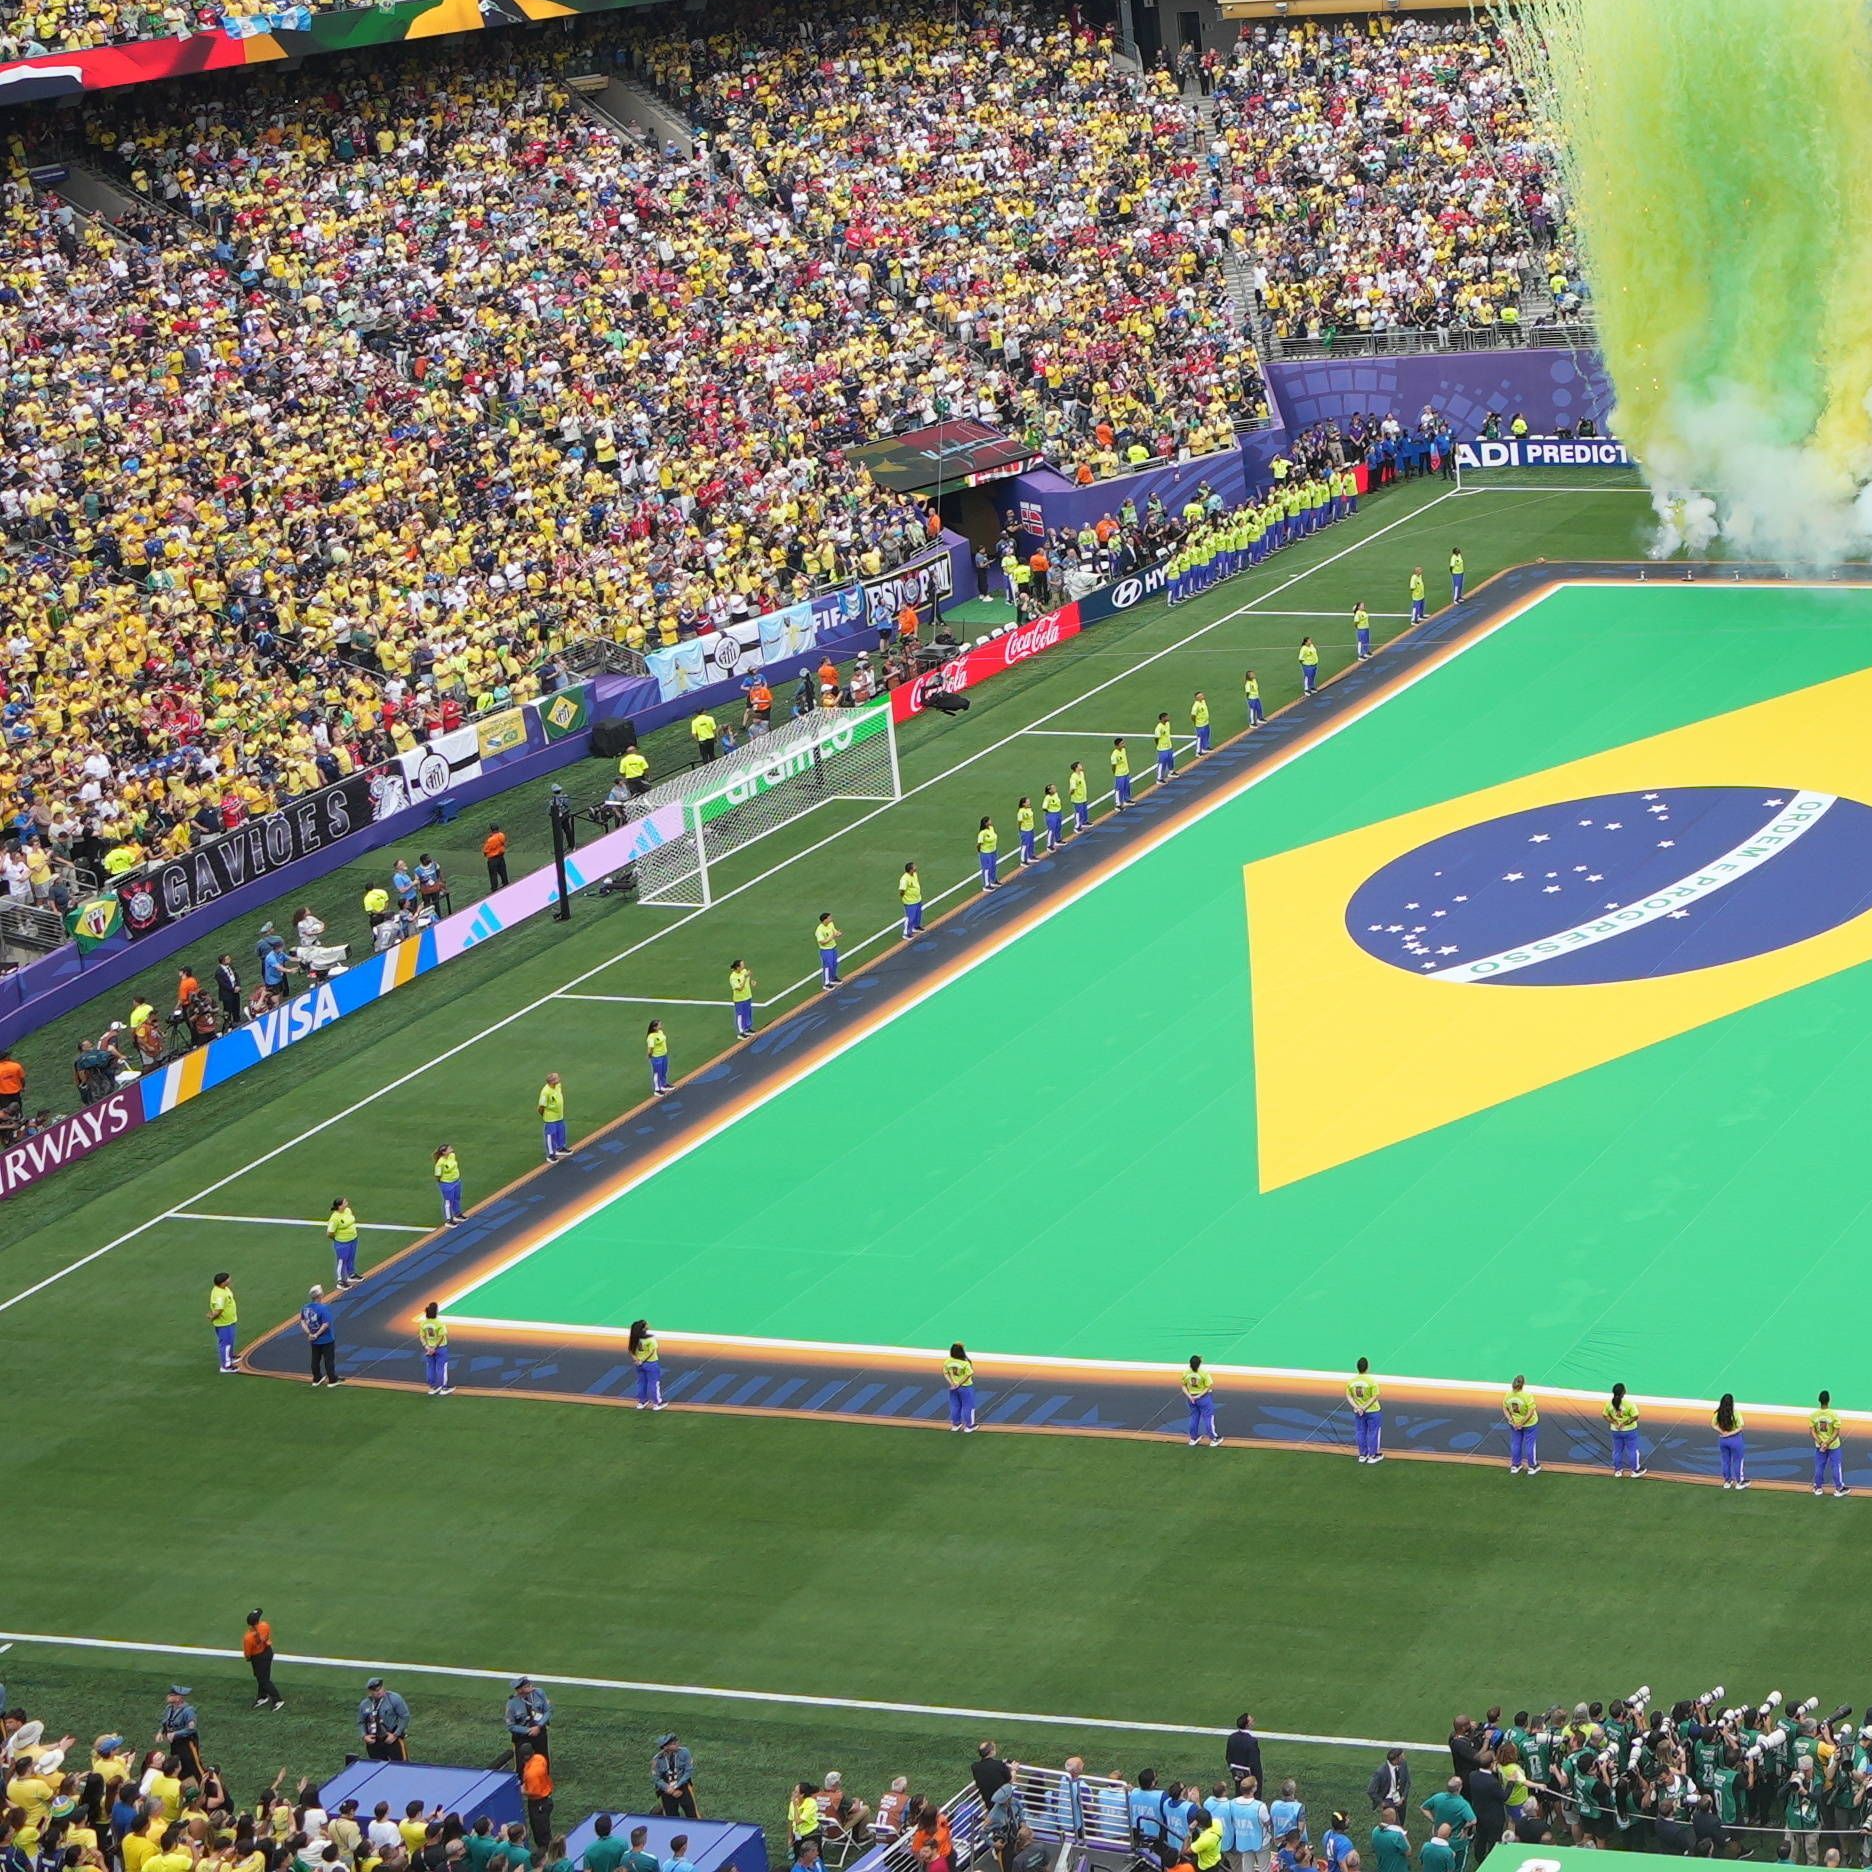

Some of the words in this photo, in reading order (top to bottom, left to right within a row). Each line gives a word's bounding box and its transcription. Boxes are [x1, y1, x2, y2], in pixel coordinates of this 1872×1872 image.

[1456, 442, 1520, 468] ADI
[1526, 444, 1643, 464] PREDICT
[1737, 801, 1822, 858] ORDEM
[1711, 862, 1737, 873] E
[1470, 875, 1714, 974] PROGRESSO
[241, 982, 340, 1059] VISA
